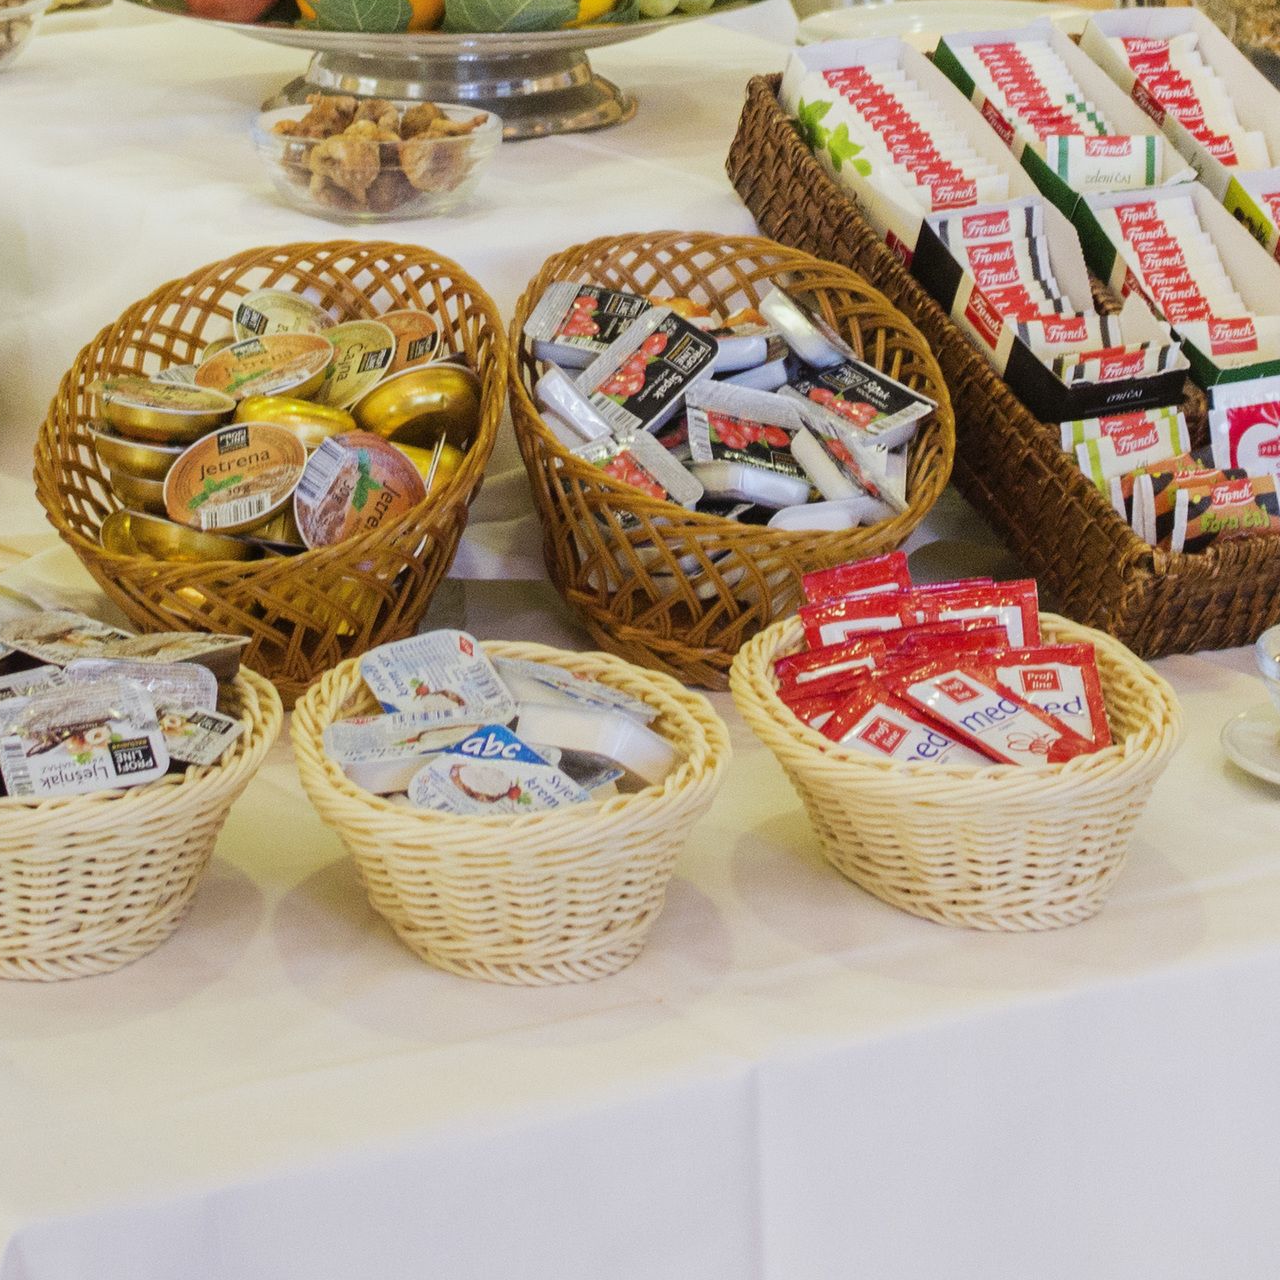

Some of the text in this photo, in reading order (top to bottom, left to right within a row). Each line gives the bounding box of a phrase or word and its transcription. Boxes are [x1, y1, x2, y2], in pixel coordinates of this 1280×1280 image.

[1154, 84, 1194, 99] Franck
[1087, 139, 1132, 157] Franck
[934, 183, 977, 202] Franck
[1120, 206, 1157, 223] Franck
[966, 219, 1010, 237] Franck
[1127, 224, 1167, 242] Franck
[971, 246, 1014, 264] Franck
[1143, 252, 1185, 269] Franck
[977, 266, 1019, 285] Franck
[1157, 286, 1199, 302] Franck
[971, 293, 1002, 337] Franck
[1046, 322, 1087, 342] Franck
[1213, 323, 1255, 340] Franck
[1102, 356, 1144, 378] Franck
[1118, 430, 1159, 453] Franck
[199, 449, 271, 481] Jetrena
[1211, 481, 1253, 504] Franck
[1027, 671, 1054, 681] Profi
[1032, 681, 1053, 690] line
[1032, 695, 1084, 716] ed
[959, 697, 1020, 734] med
[461, 733, 522, 760] abc
[906, 727, 952, 762] ed
[114, 749, 143, 762] LINE
[117, 757, 154, 774] PROFI
